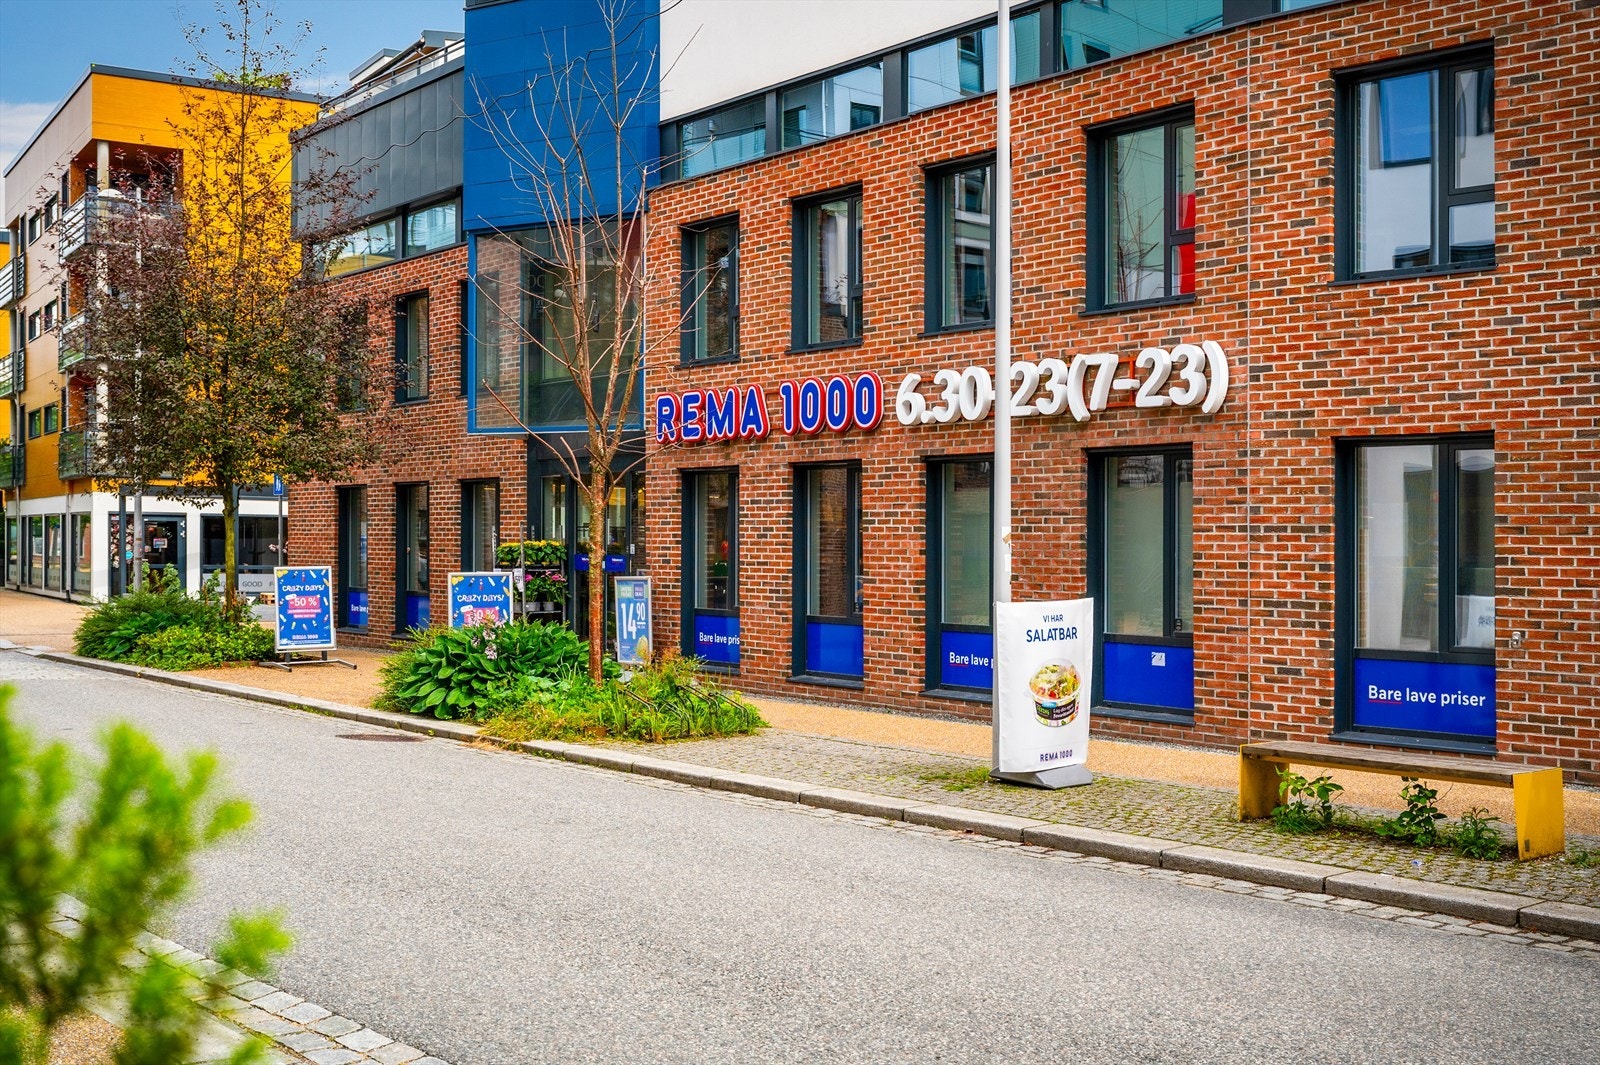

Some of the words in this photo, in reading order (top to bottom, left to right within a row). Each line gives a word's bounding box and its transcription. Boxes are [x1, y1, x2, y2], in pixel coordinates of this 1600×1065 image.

[656, 383, 770, 444] REMA
[779, 371, 884, 436] 1000
[290, 597, 307, 607] -50
[621, 603, 637, 640] 14
[636, 602, 646, 621] 90
[1042, 614, 1050, 623] VI
[1050, 613, 1064, 623] HAR
[699, 632, 714, 643] Bare
[714, 633, 727, 644] lave
[1026, 626, 1078, 642] SALATBAR
[949, 651, 970, 665] Bare
[970, 653, 989, 666] lave
[1368, 684, 1402, 701] Bare
[1405, 687, 1437, 704] lave
[1440, 690, 1486, 707] priser
[1039, 751, 1058, 762] REMA
